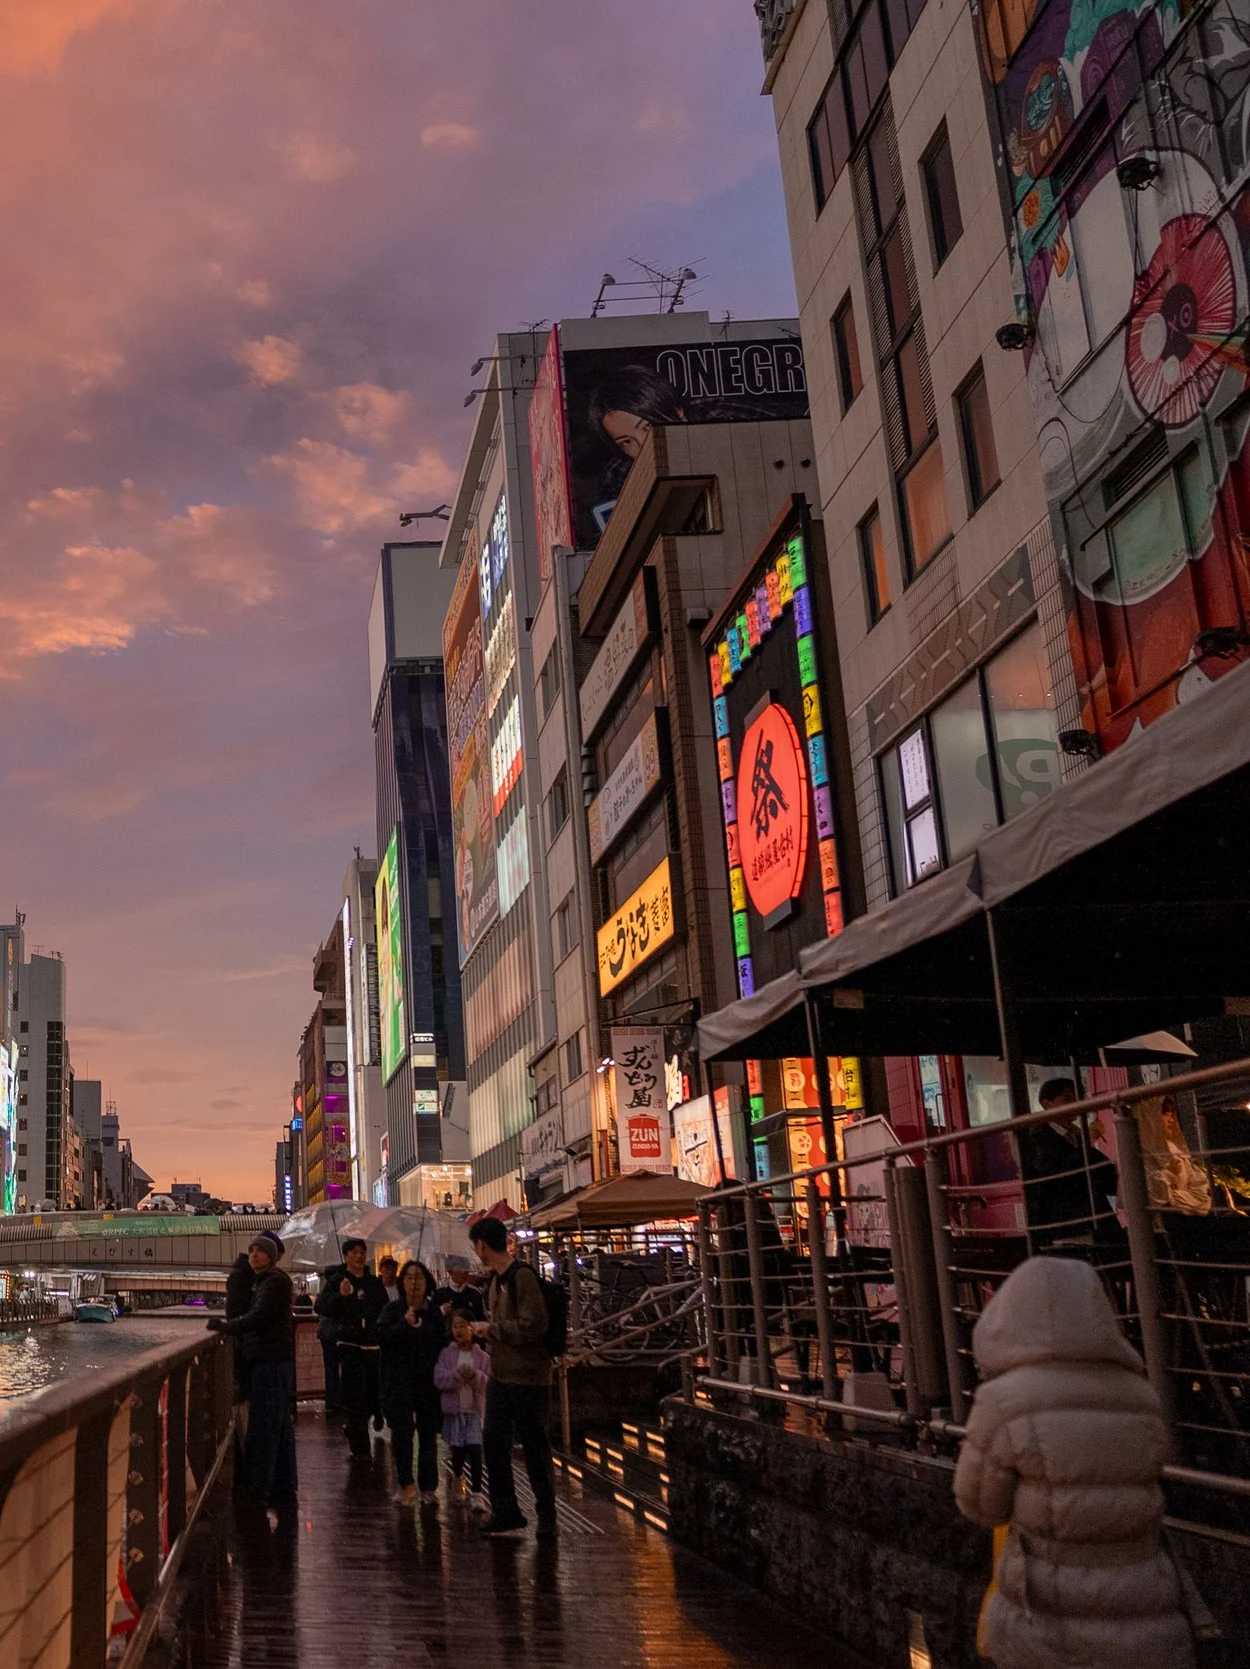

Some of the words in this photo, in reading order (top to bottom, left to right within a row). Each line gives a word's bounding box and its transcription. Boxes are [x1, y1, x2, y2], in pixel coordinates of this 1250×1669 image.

[609, 896, 650, 978] うなぎ
[630, 1127, 658, 1142] ZUN
